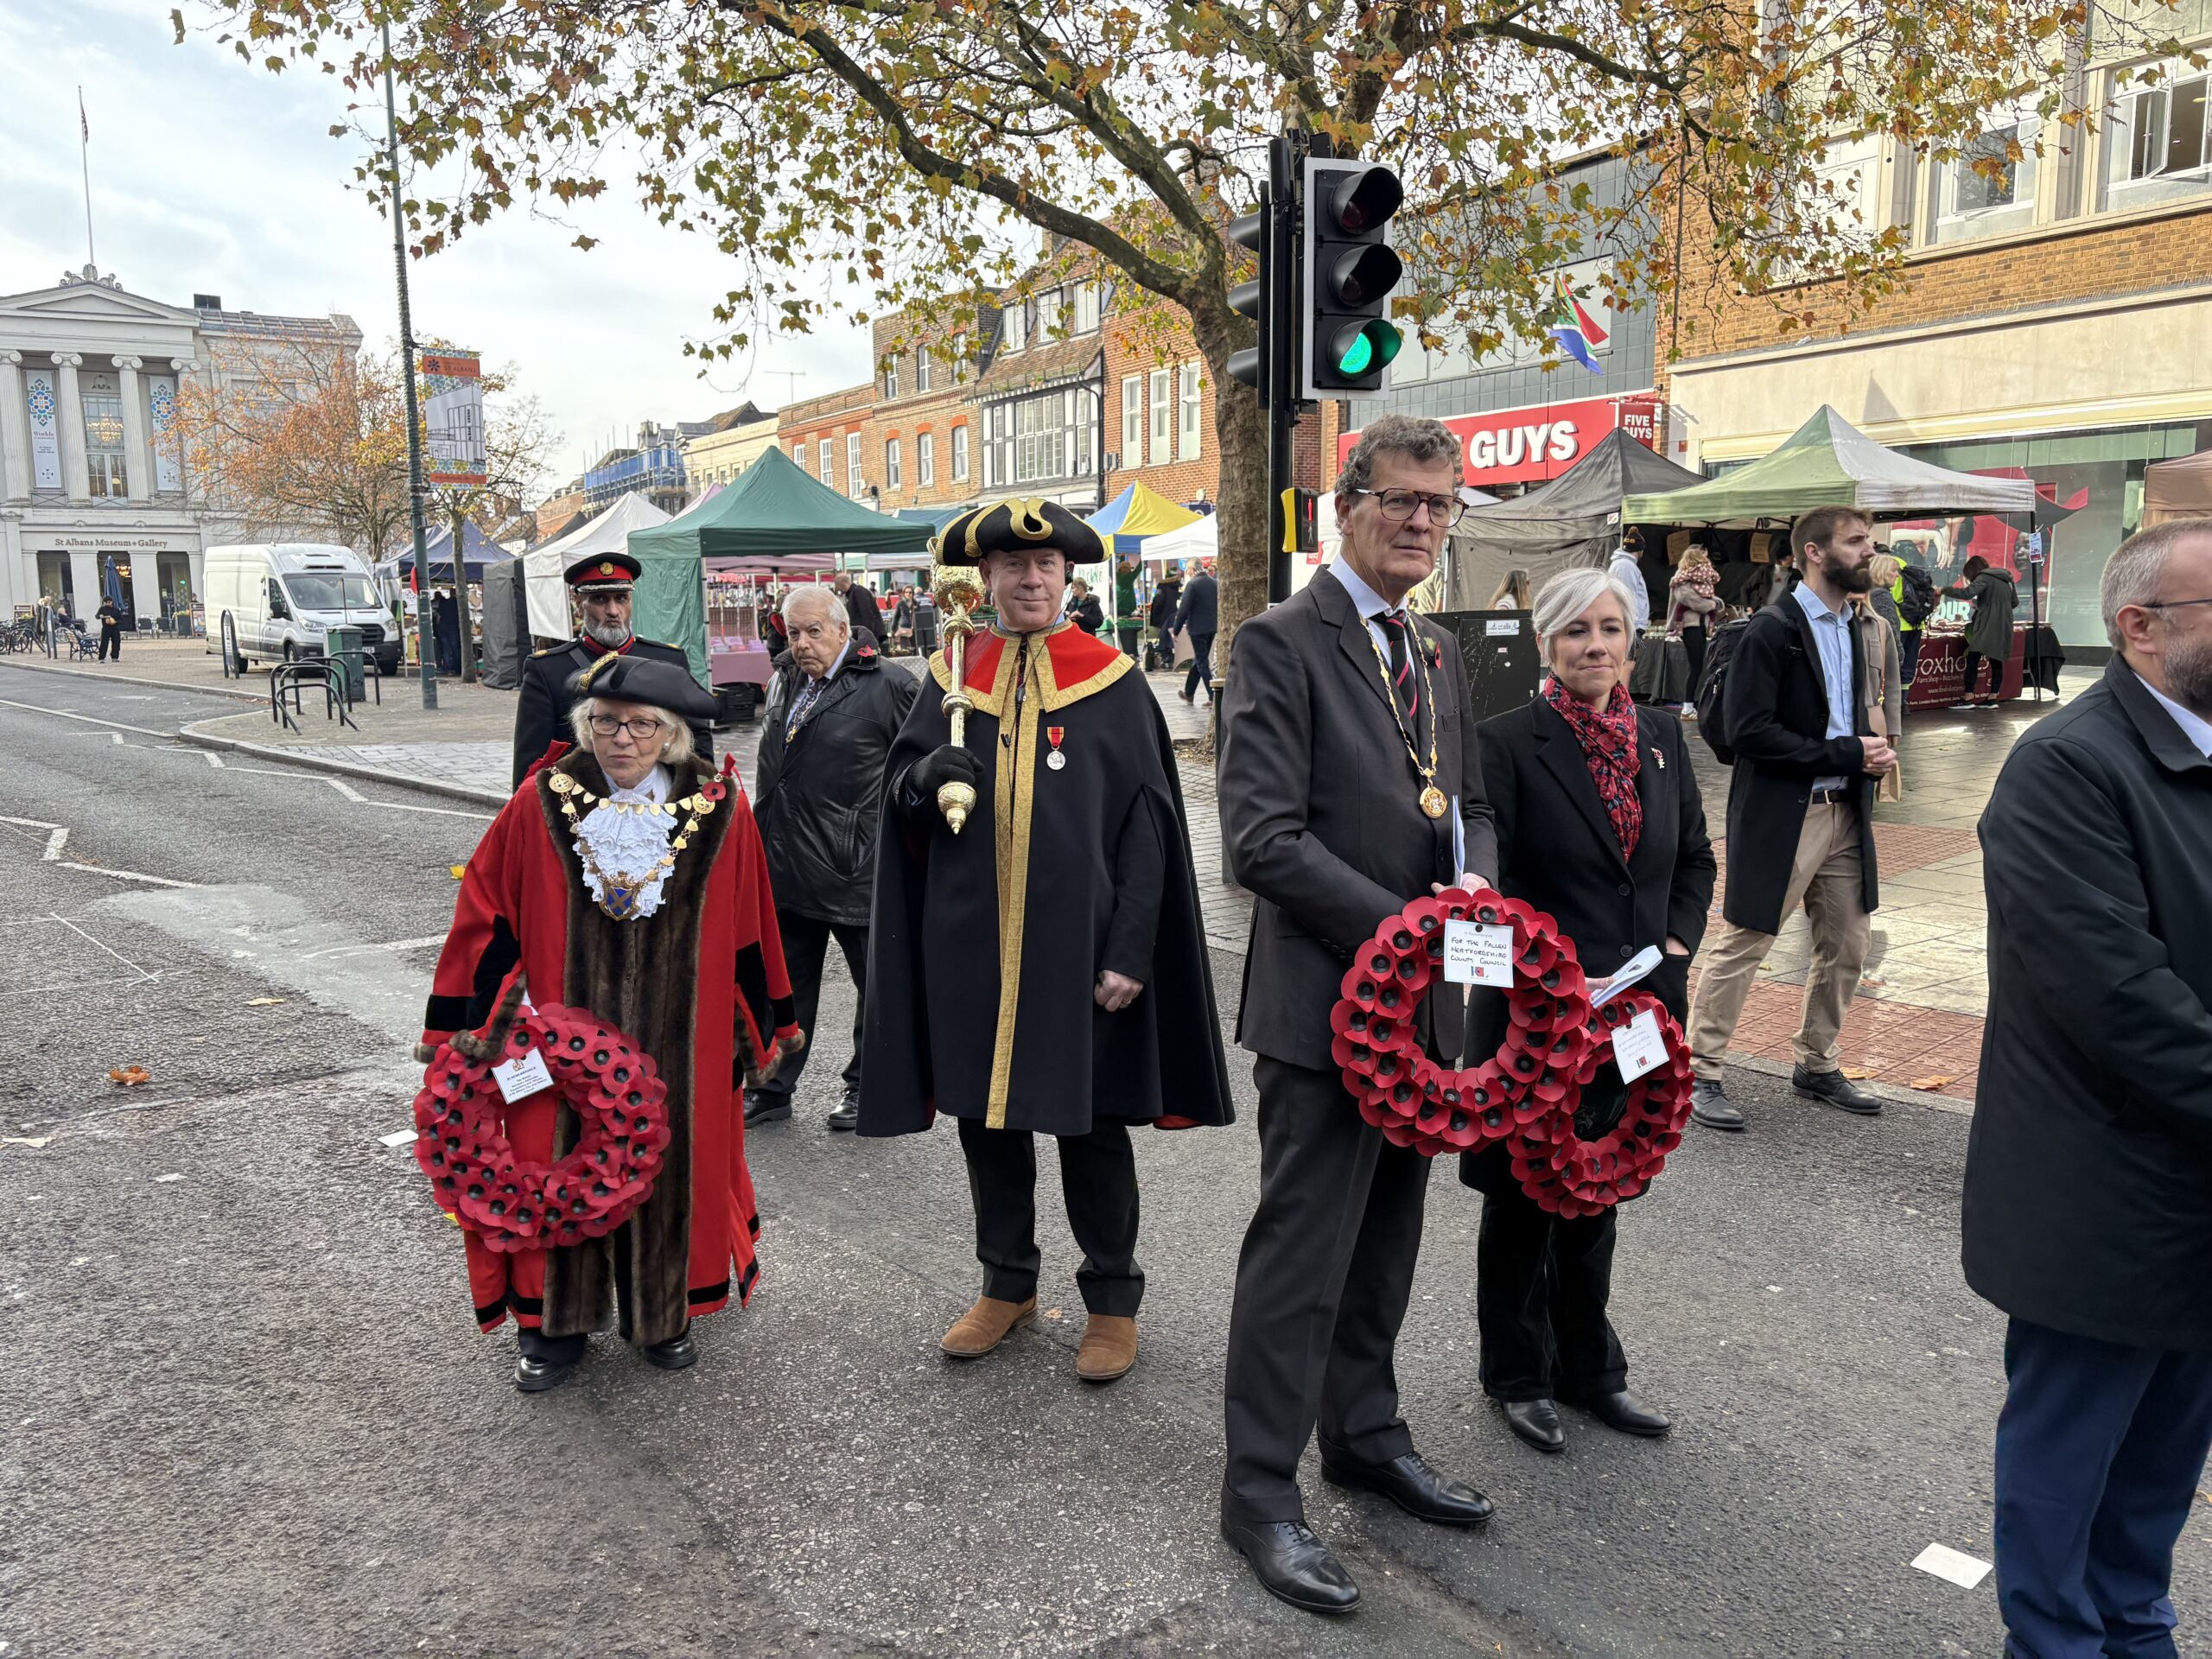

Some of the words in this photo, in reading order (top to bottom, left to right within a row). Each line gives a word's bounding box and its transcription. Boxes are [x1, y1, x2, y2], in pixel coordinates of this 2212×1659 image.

[1624, 414, 1650, 426] FIVE
[1469, 420, 1579, 469] GUYS
[138, 539, 168, 548] Gallery
[1484, 941, 1507, 949] FALLEN
[1451, 946, 1507, 959] HERTFORDSHIRE
